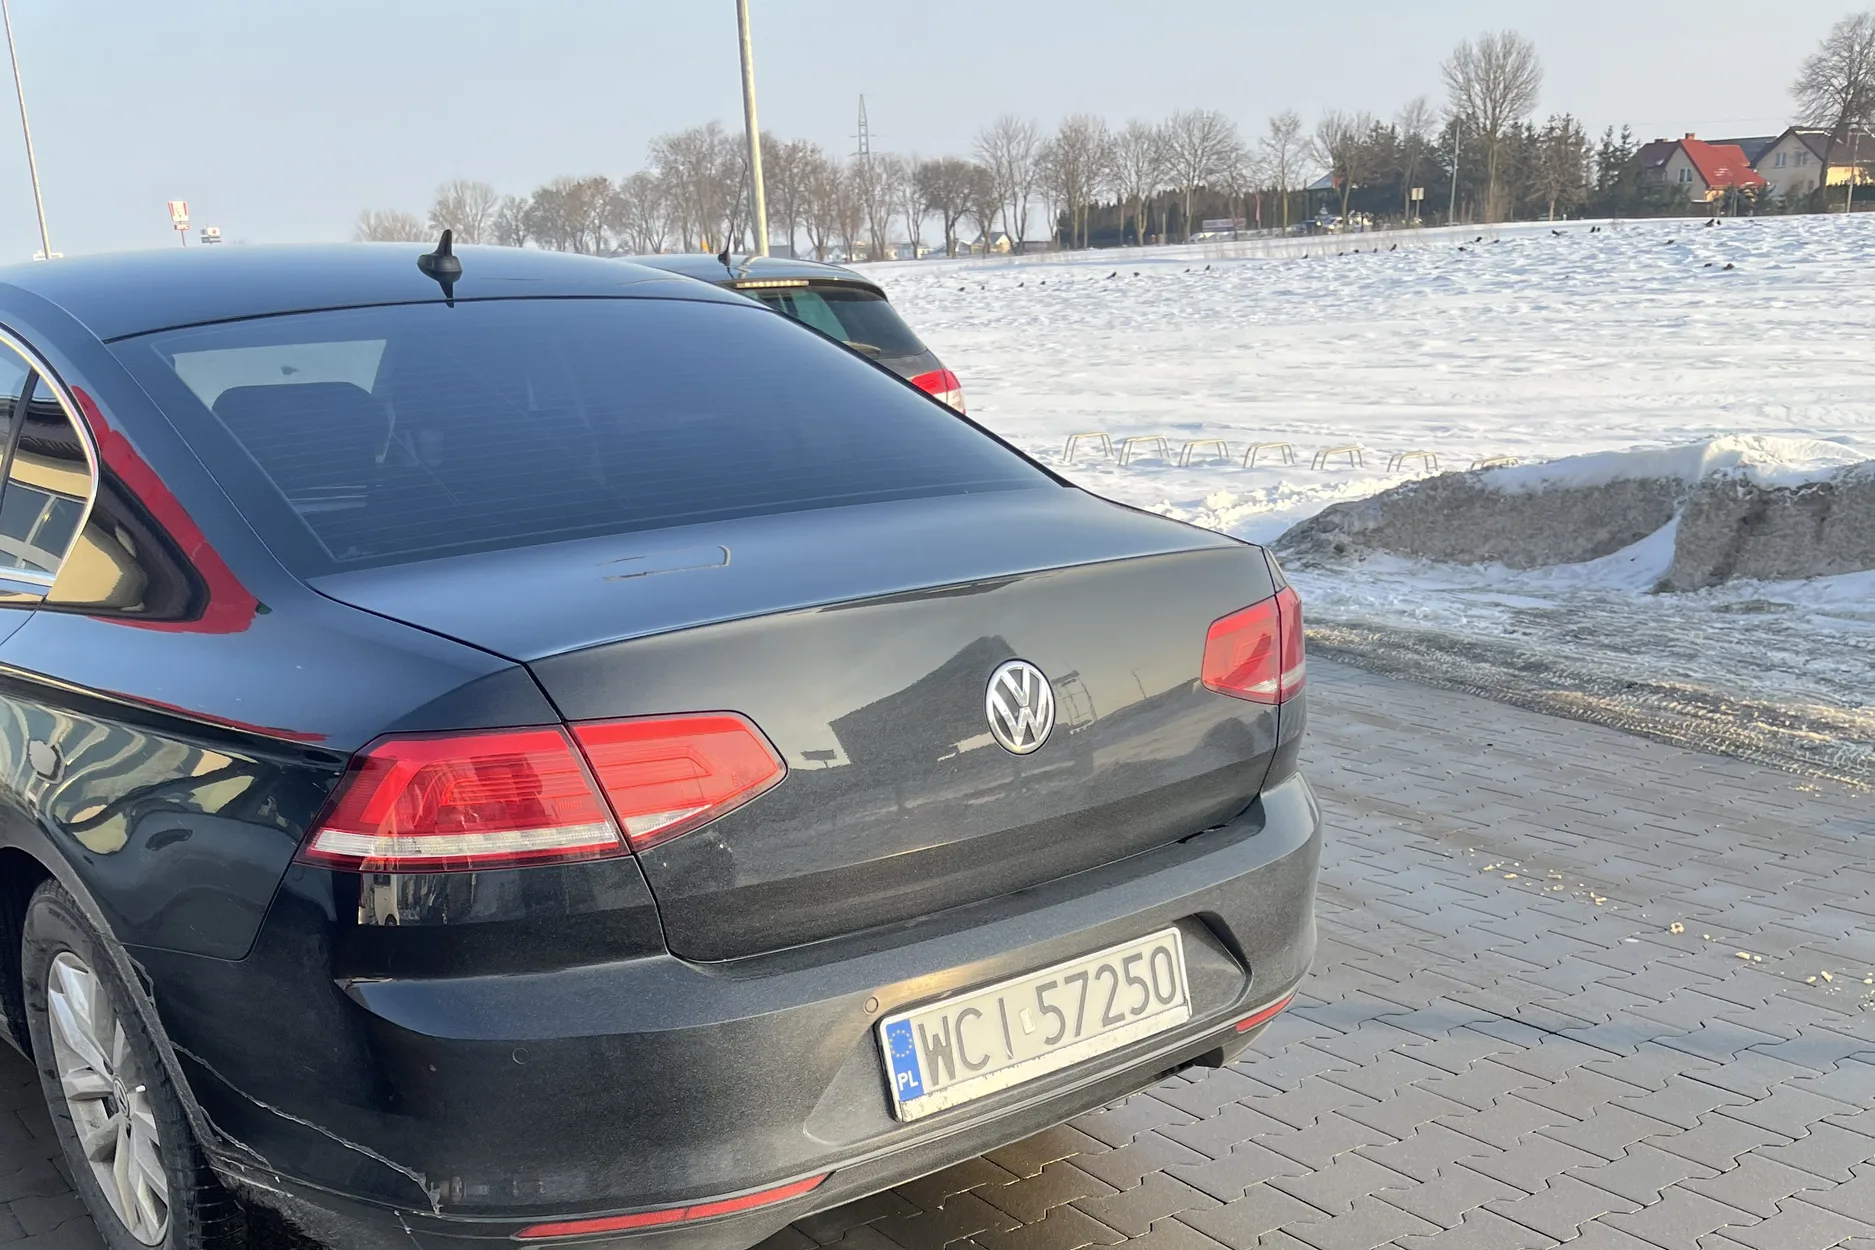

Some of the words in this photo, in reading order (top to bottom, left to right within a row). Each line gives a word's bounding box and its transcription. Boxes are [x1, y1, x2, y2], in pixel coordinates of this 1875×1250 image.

[987, 661, 1053, 753] VW
[918, 997, 1013, 1087] WCI
[1036, 945, 1177, 1046] 57250
[897, 1070, 919, 1091] PL
